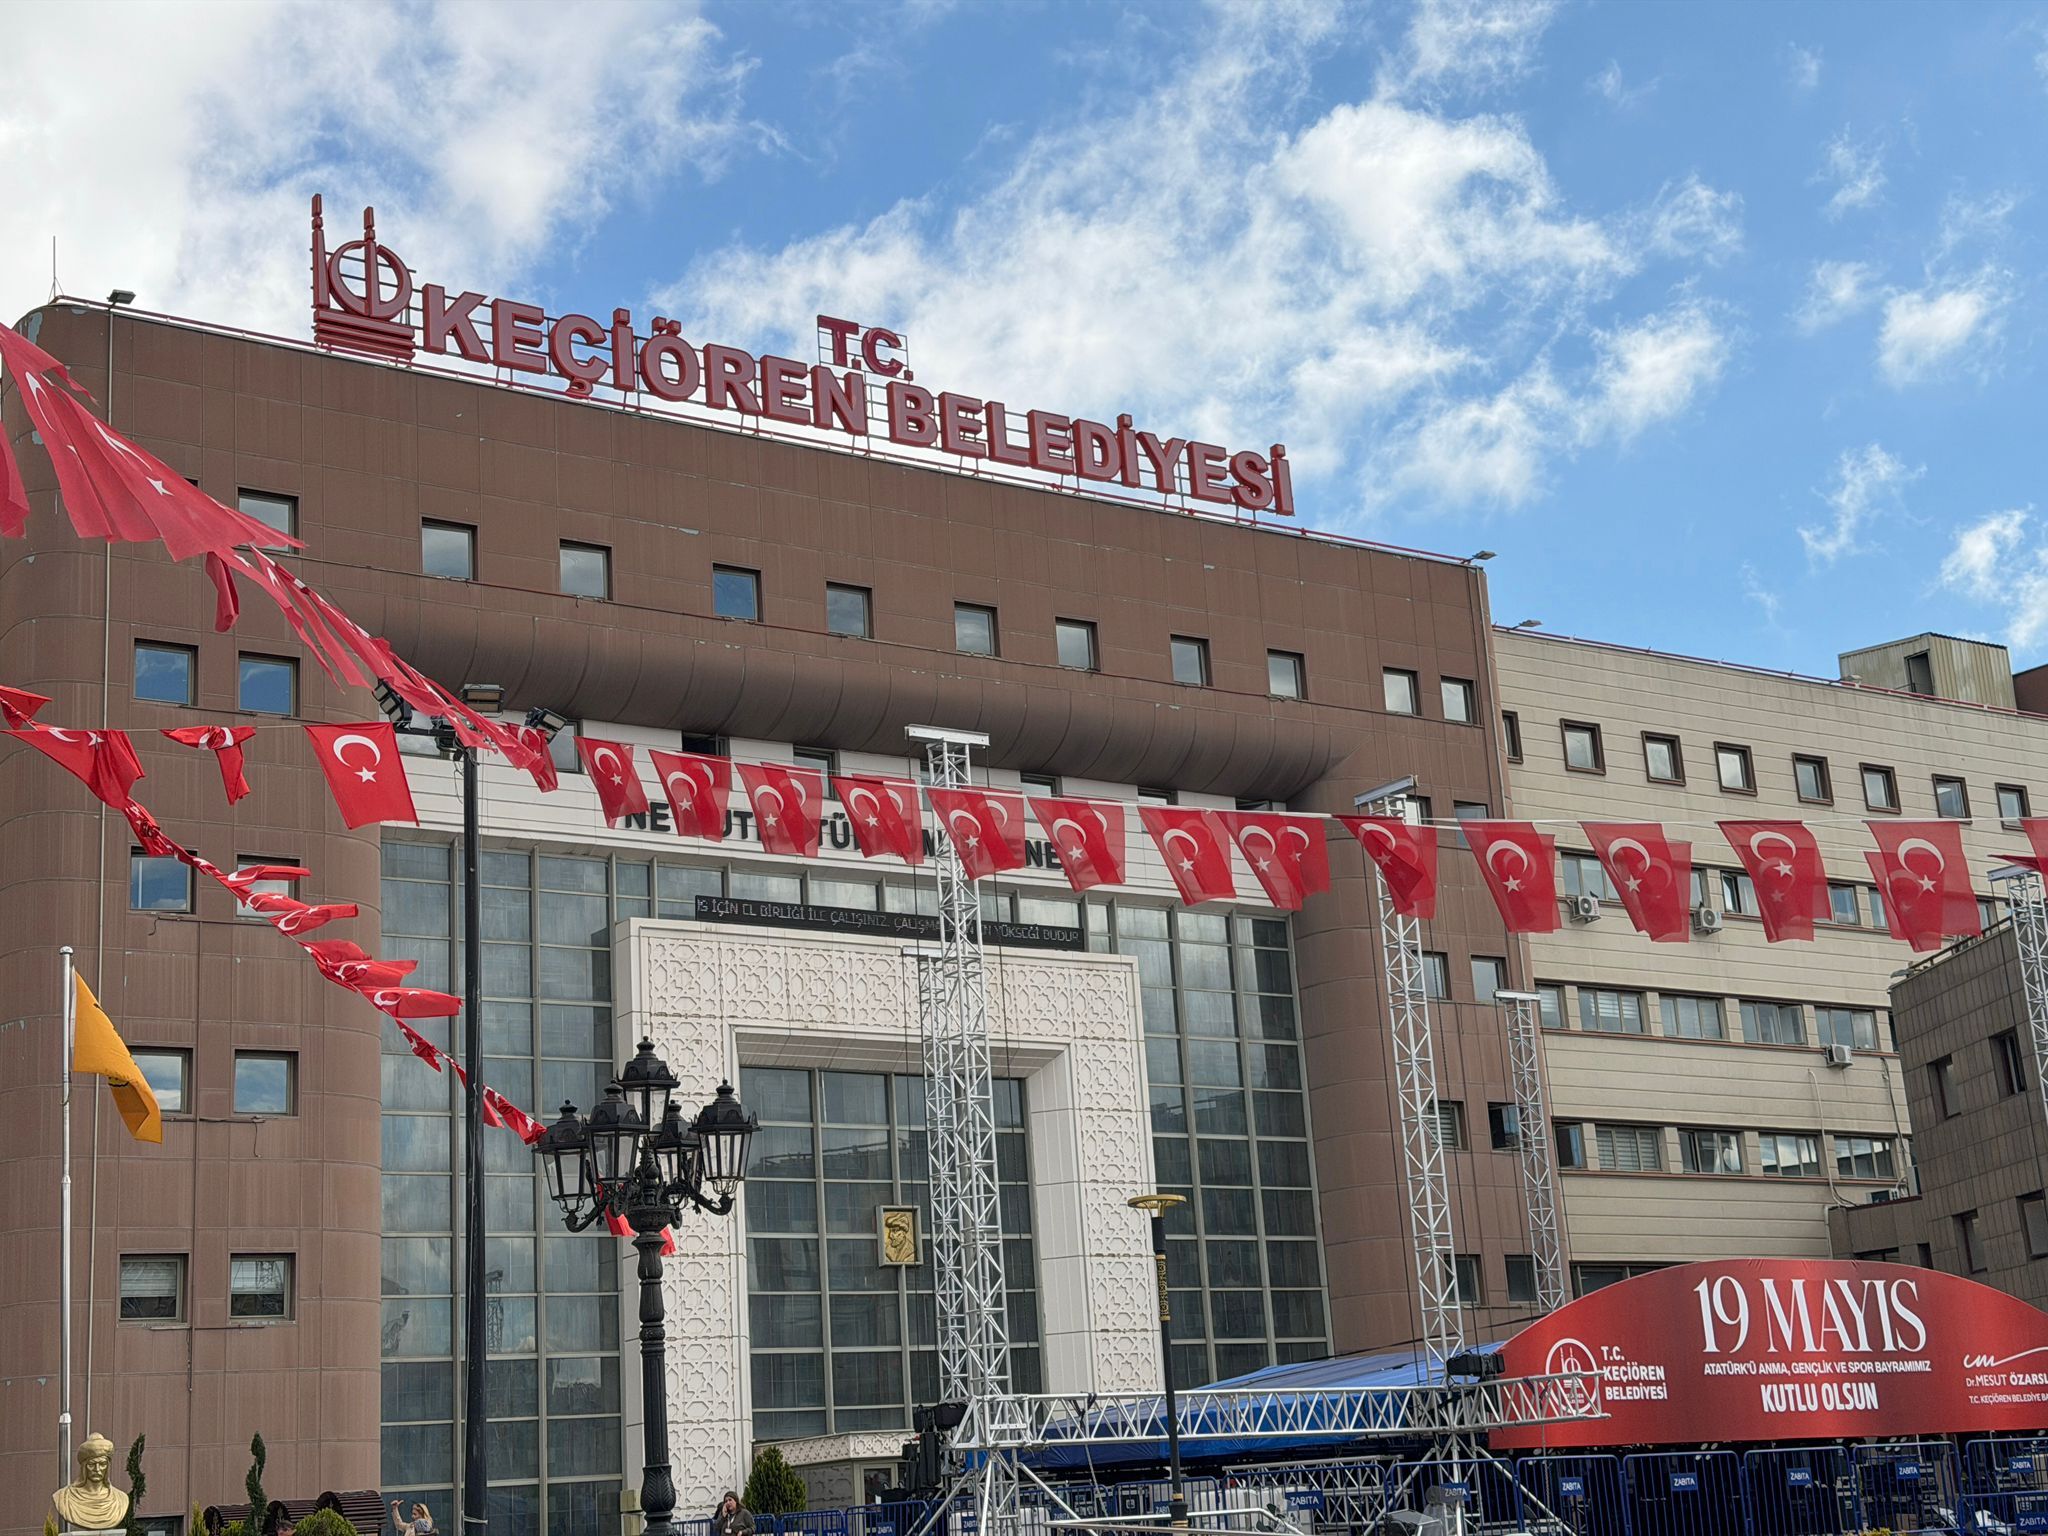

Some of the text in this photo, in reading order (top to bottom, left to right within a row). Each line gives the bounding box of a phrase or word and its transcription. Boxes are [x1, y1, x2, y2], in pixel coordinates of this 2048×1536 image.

[816, 315, 914, 381] T.C.
[422, 283, 1296, 517] KEÇİÖREN BELEDİYESİ
[1693, 1275, 1927, 1354] 19 MAYIS
[1600, 1346, 1625, 1361] T.C.
[1603, 1362, 1665, 1382] KEÇİÖREN
[1704, 1360, 1932, 1377] ATATÜRK'Ü ANMA, GENÇLİK VE SPOR BAYRAMIMIZ
[1605, 1383, 1668, 1400] BELEDİYESİ
[1760, 1381, 1879, 1413] KUTLU OLSUN
[1898, 1466, 1918, 1475] ZABITA
[2011, 1461, 2031, 1470] ZABITA
[1673, 1477, 1696, 1487] ZABITA
[1789, 1471, 1810, 1481] ZABITA
[1562, 1482, 1581, 1491] ZABITA
[1290, 1496, 1320, 1506] ZABITA
[2019, 1517, 2048, 1527] ZABITA
